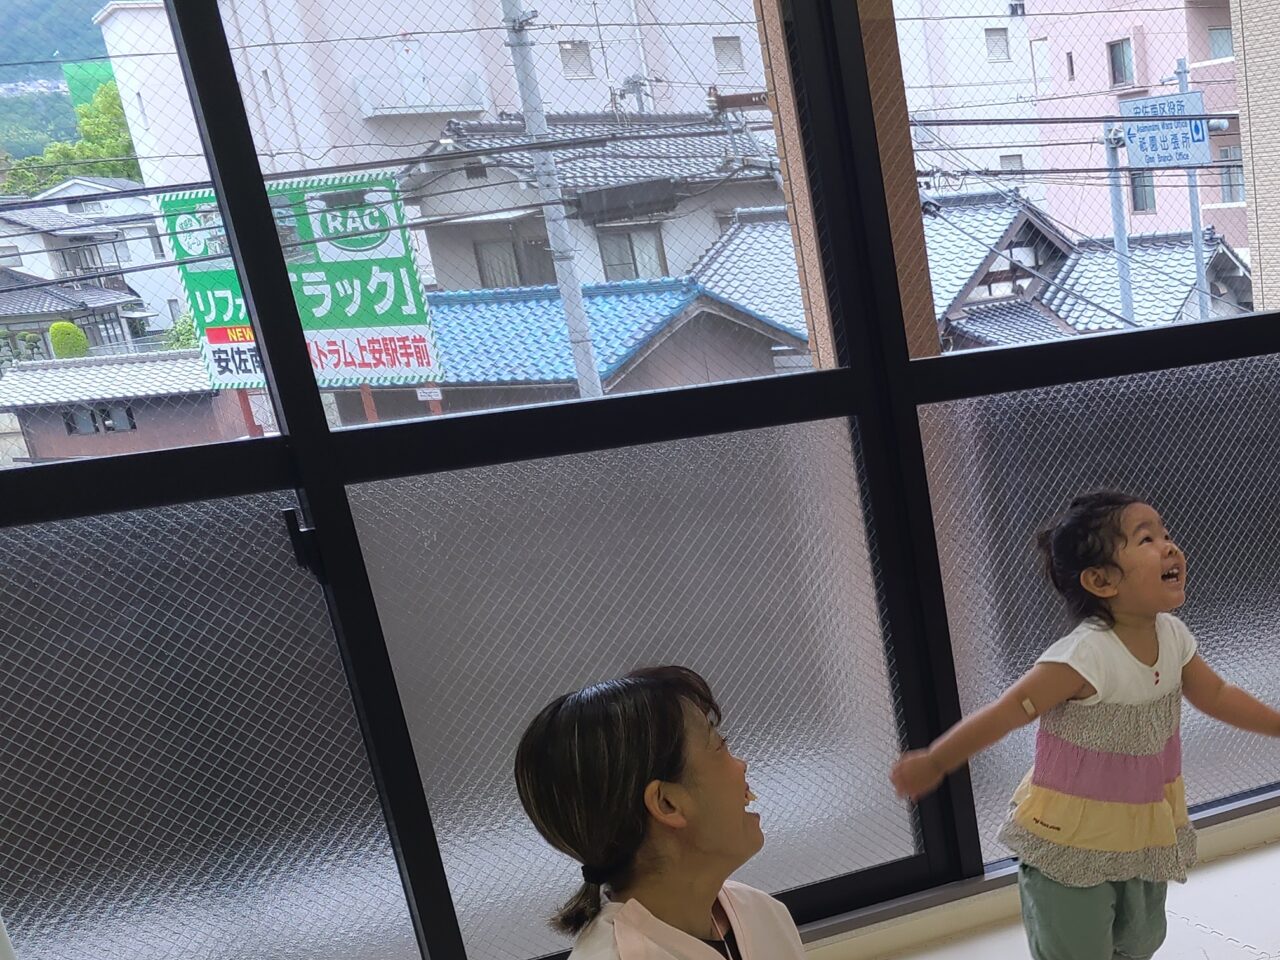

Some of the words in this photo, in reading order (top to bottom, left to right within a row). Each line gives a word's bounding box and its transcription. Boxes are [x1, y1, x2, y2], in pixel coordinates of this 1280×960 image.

[326, 208, 381, 233] RAC
[289, 266, 417, 319] ラック」
